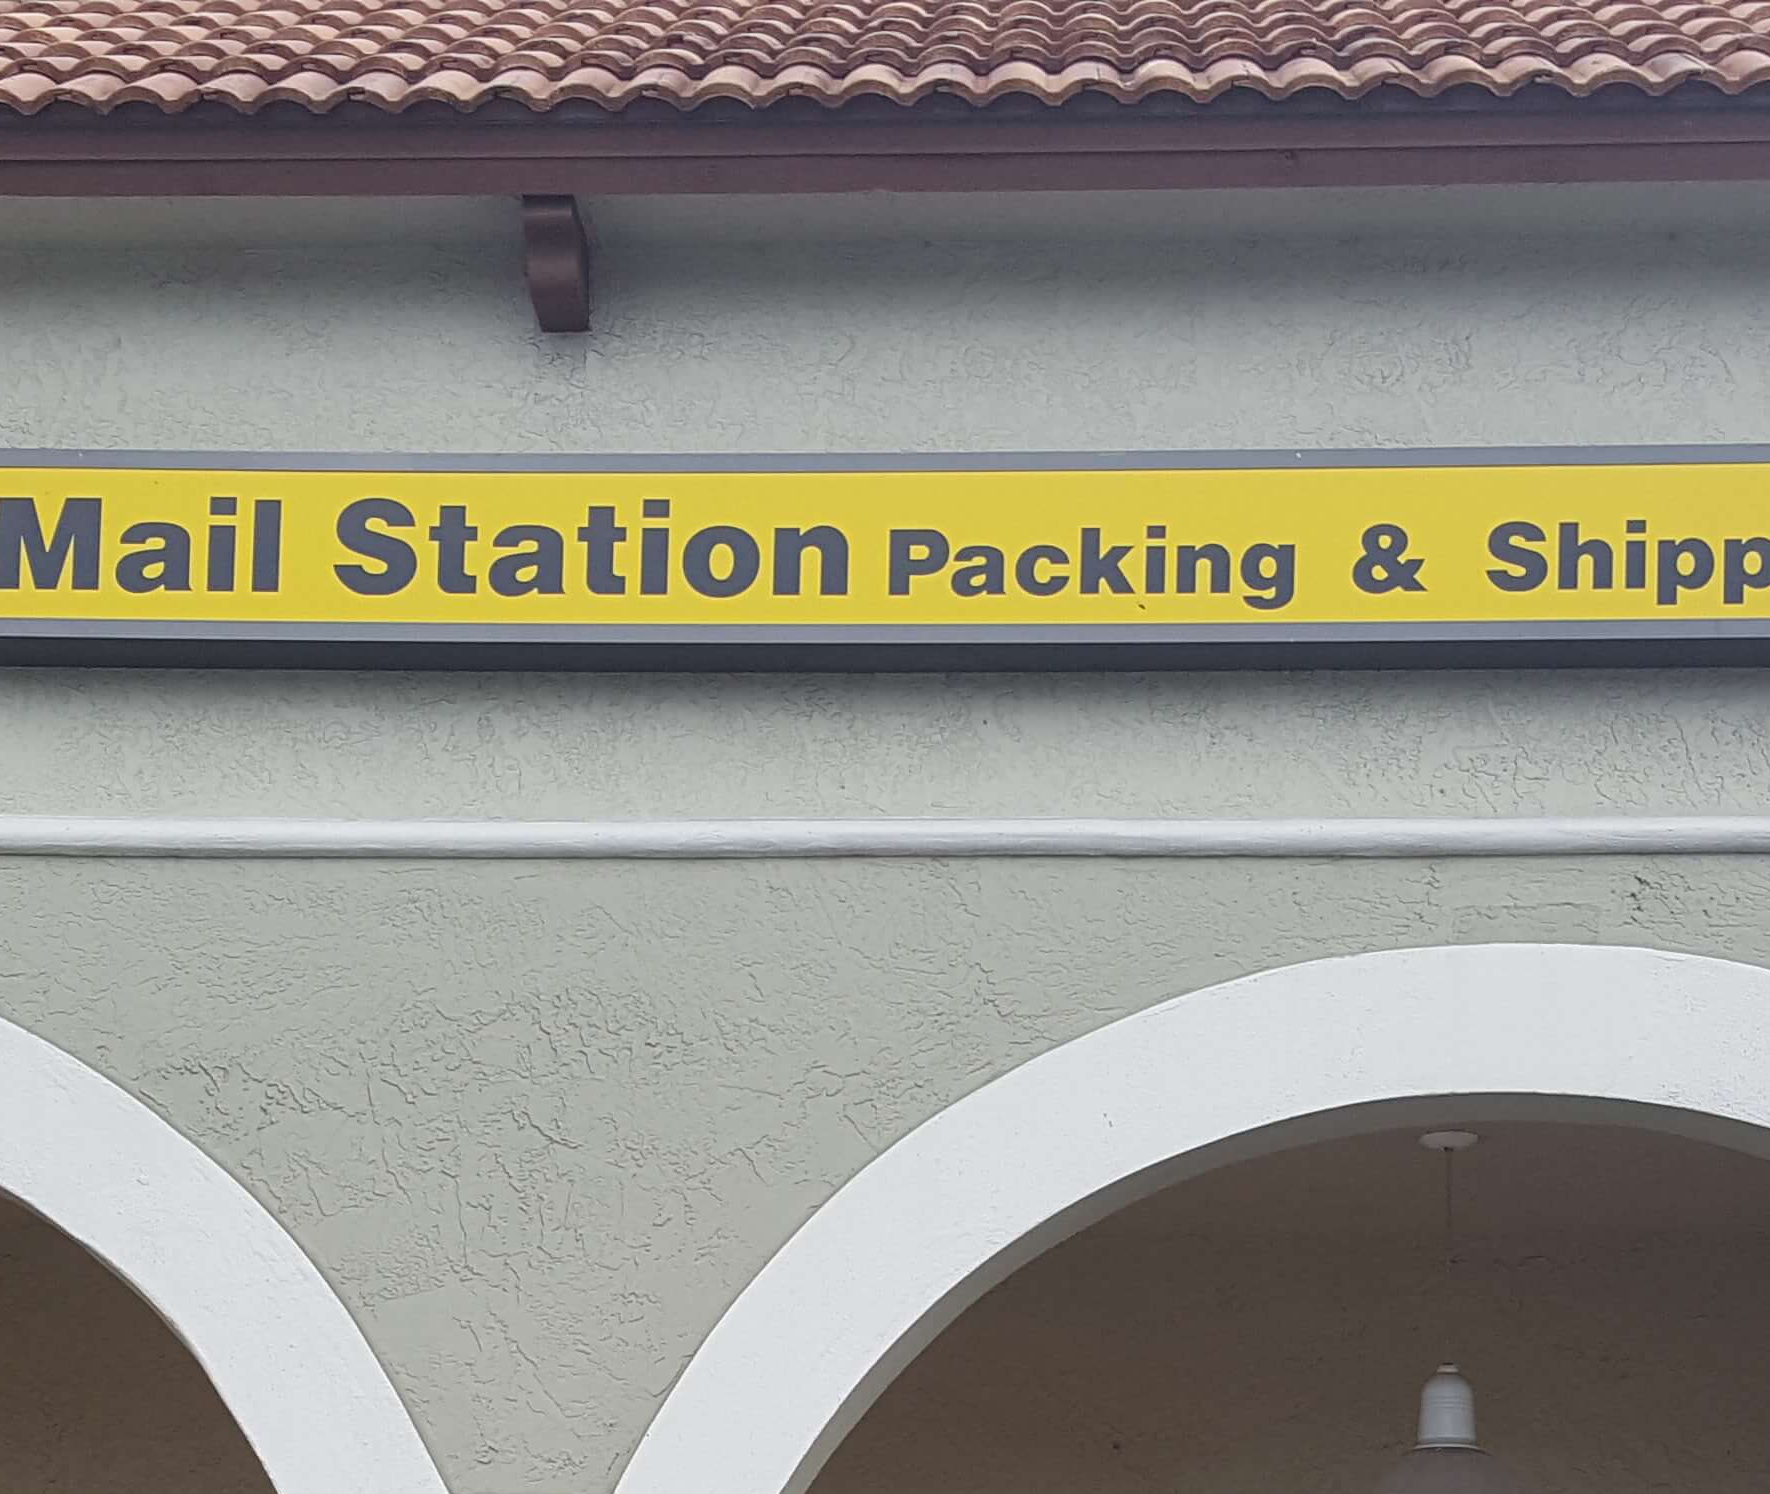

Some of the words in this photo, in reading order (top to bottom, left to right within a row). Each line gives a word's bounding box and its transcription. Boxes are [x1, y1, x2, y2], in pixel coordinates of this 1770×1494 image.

[332, 497, 849, 598] Station
[887, 525, 1296, 609] Packing
[1350, 523, 1428, 593] &
